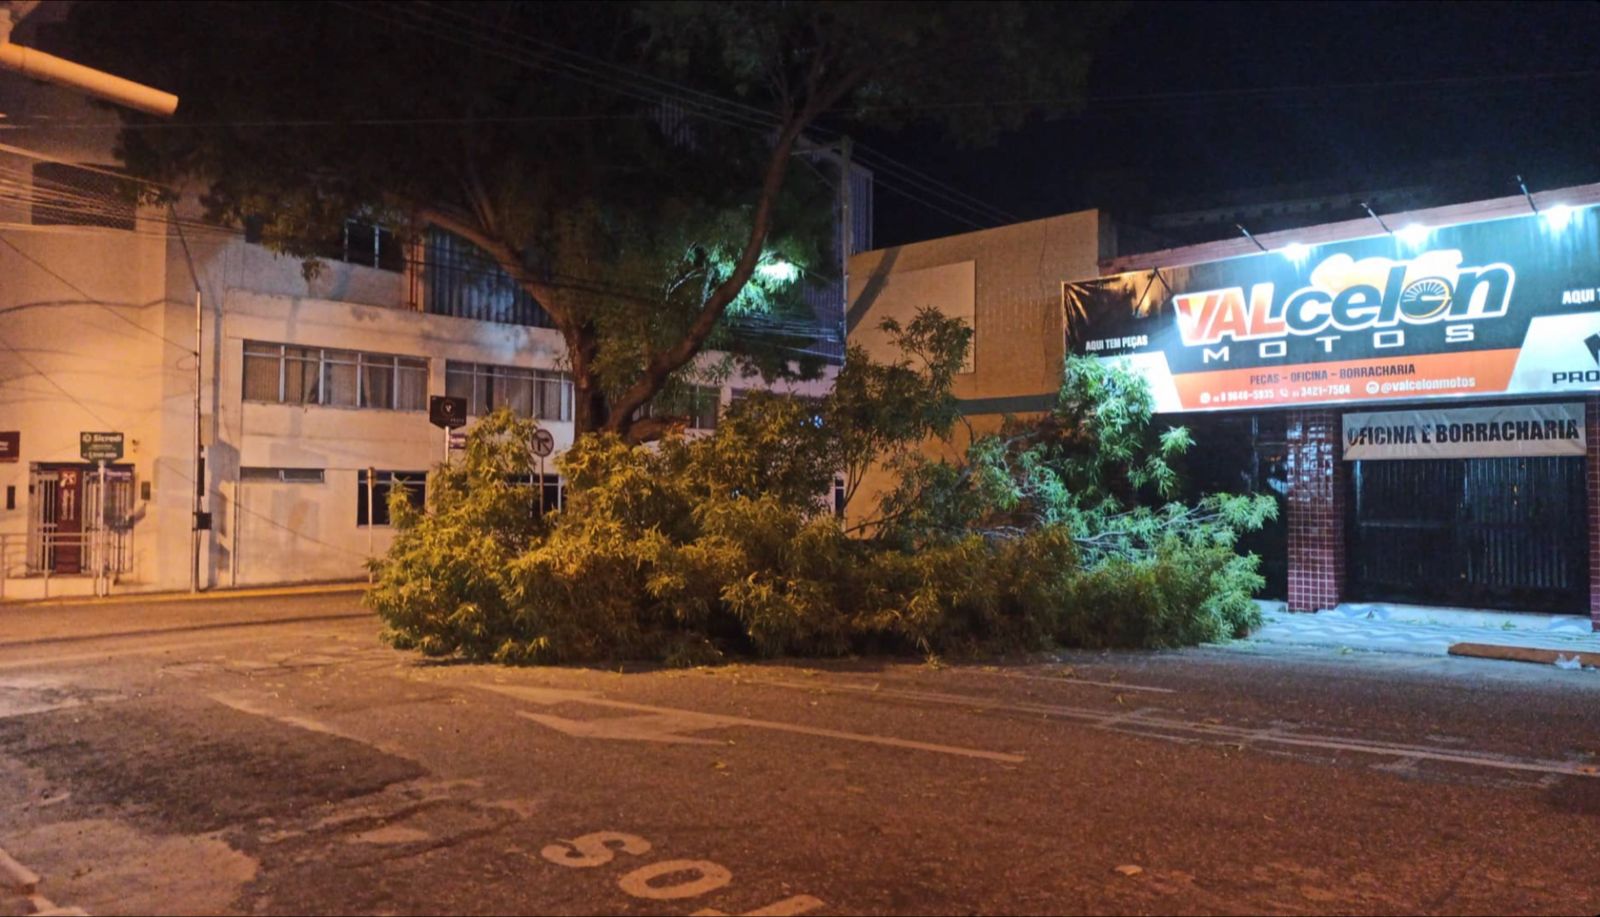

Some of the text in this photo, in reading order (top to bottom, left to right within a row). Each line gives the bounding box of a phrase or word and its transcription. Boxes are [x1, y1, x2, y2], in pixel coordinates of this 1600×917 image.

[1562, 288, 1595, 305] AQUI
[1086, 335, 1148, 351] AQUI TEM PEÇAS
[1203, 324, 1475, 363] MOTOS
[1290, 370, 1328, 383] OFICINA
[1339, 363, 1416, 379] BORRACHARIA
[1347, 419, 1580, 447] OFICINA E BORRACHARIA
